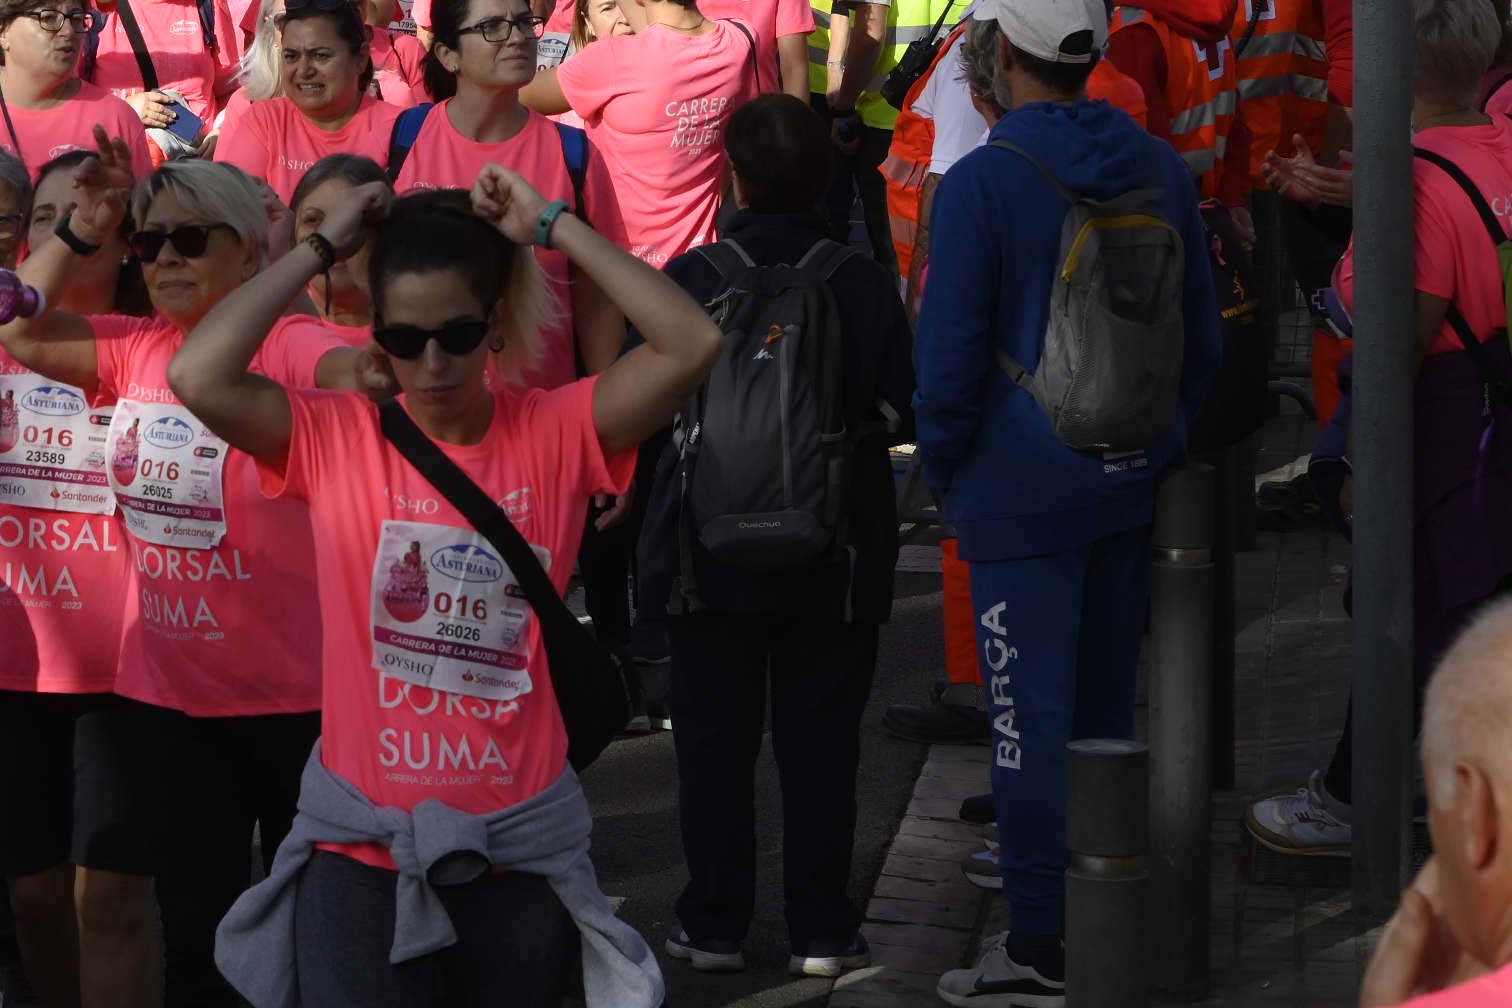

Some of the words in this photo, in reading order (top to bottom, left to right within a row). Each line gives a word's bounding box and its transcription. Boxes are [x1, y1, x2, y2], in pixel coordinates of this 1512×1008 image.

[677, 115, 700, 133] DE
[24, 395, 81, 412] ASTURIANA
[23, 425, 73, 447] 016
[25, 450, 66, 465] 23589
[1103, 460, 1128, 474] SINCE
[27, 468, 41, 477] DE
[41, 469, 53, 478] LA
[54, 471, 85, 482] MUJER
[140, 458, 180, 481] 016
[61, 490, 107, 504] Santander
[142, 484, 173, 499] 26025
[436, 555, 499, 580] ASTURIANA
[142, 587, 219, 629] SUMA
[433, 591, 488, 621] 016
[435, 622, 481, 642] 26026
[389, 634, 436, 652] CARRERA
[453, 645, 467, 657] LA
[466, 648, 499, 662] MUJER
[384, 653, 434, 676] OYSHO
[981, 600, 1023, 770] BARÇA
[378, 727, 509, 771] SUMA
